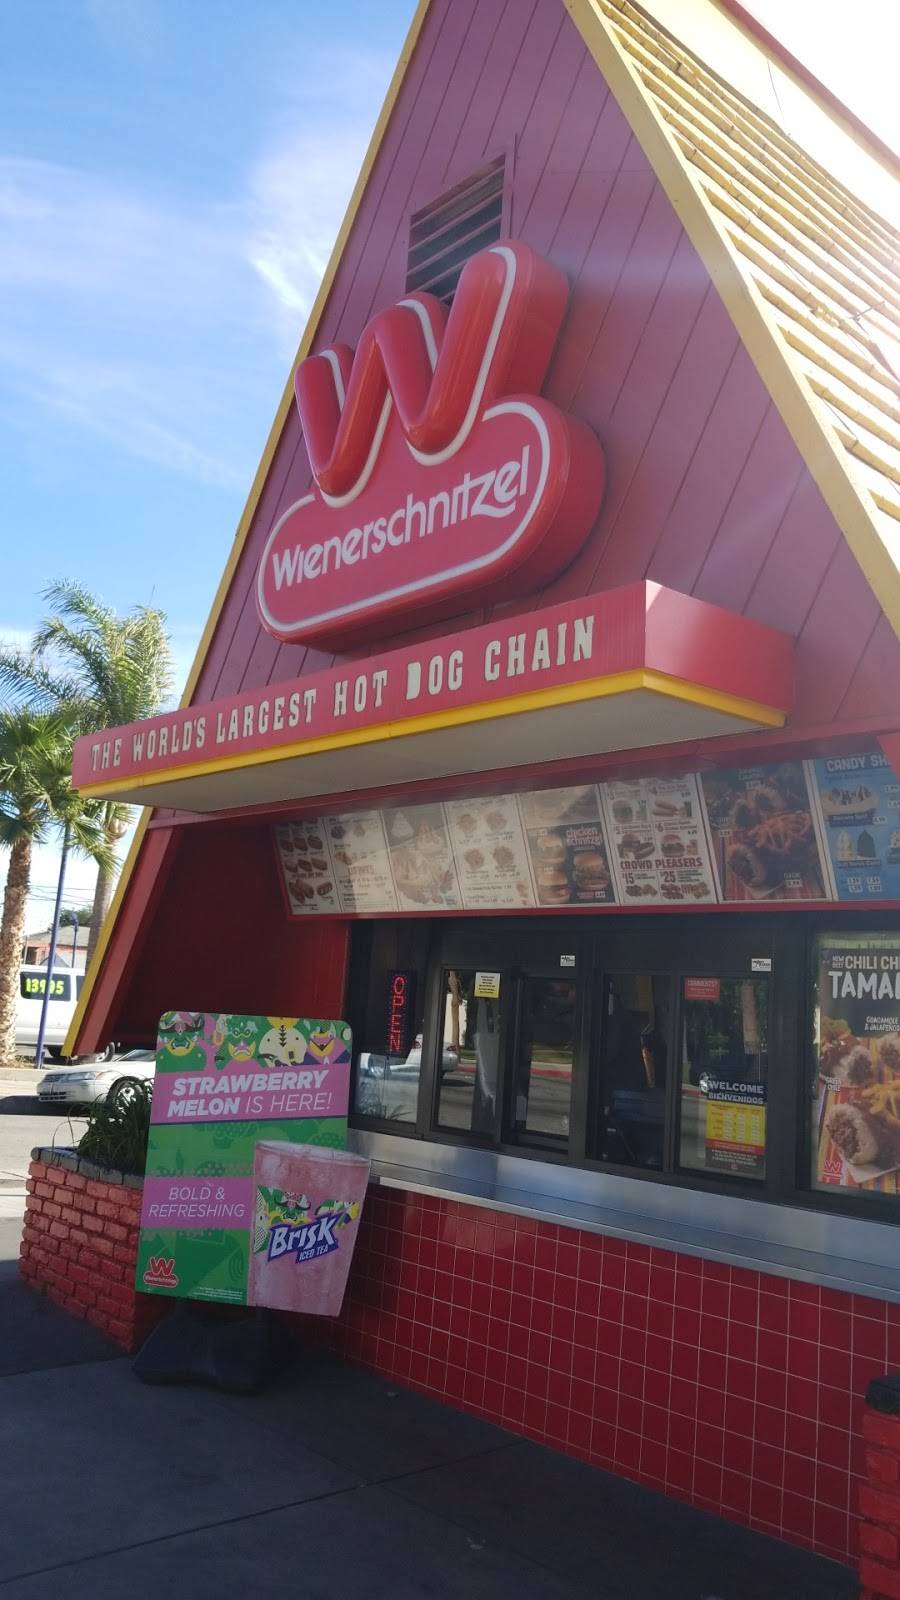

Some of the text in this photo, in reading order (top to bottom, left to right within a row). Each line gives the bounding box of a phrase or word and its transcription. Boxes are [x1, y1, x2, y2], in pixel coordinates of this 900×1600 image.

[271, 444, 531, 592] Wienerschnitzel
[91, 614, 595, 771] THE WORLD'S LARGEST HOT DOG CHAIN
[826, 754, 892, 772] CANDY SH
[620, 857, 703, 871] CROWD PLEASERS
[845, 955, 878, 970] CHILI
[388, 974, 407, 1053] OPEN
[172, 1069, 329, 1097] STRAWBERRY
[709, 1081, 764, 1094] WELCOME
[167, 1092, 333, 1118] MELON IS HERE!
[708, 1092, 764, 1105] BIENVENIDOS
[168, 1186, 225, 1201] BOLD &
[148, 1203, 245, 1218] REFRESHING
[299, 1247, 328, 1261] ICED TEA
